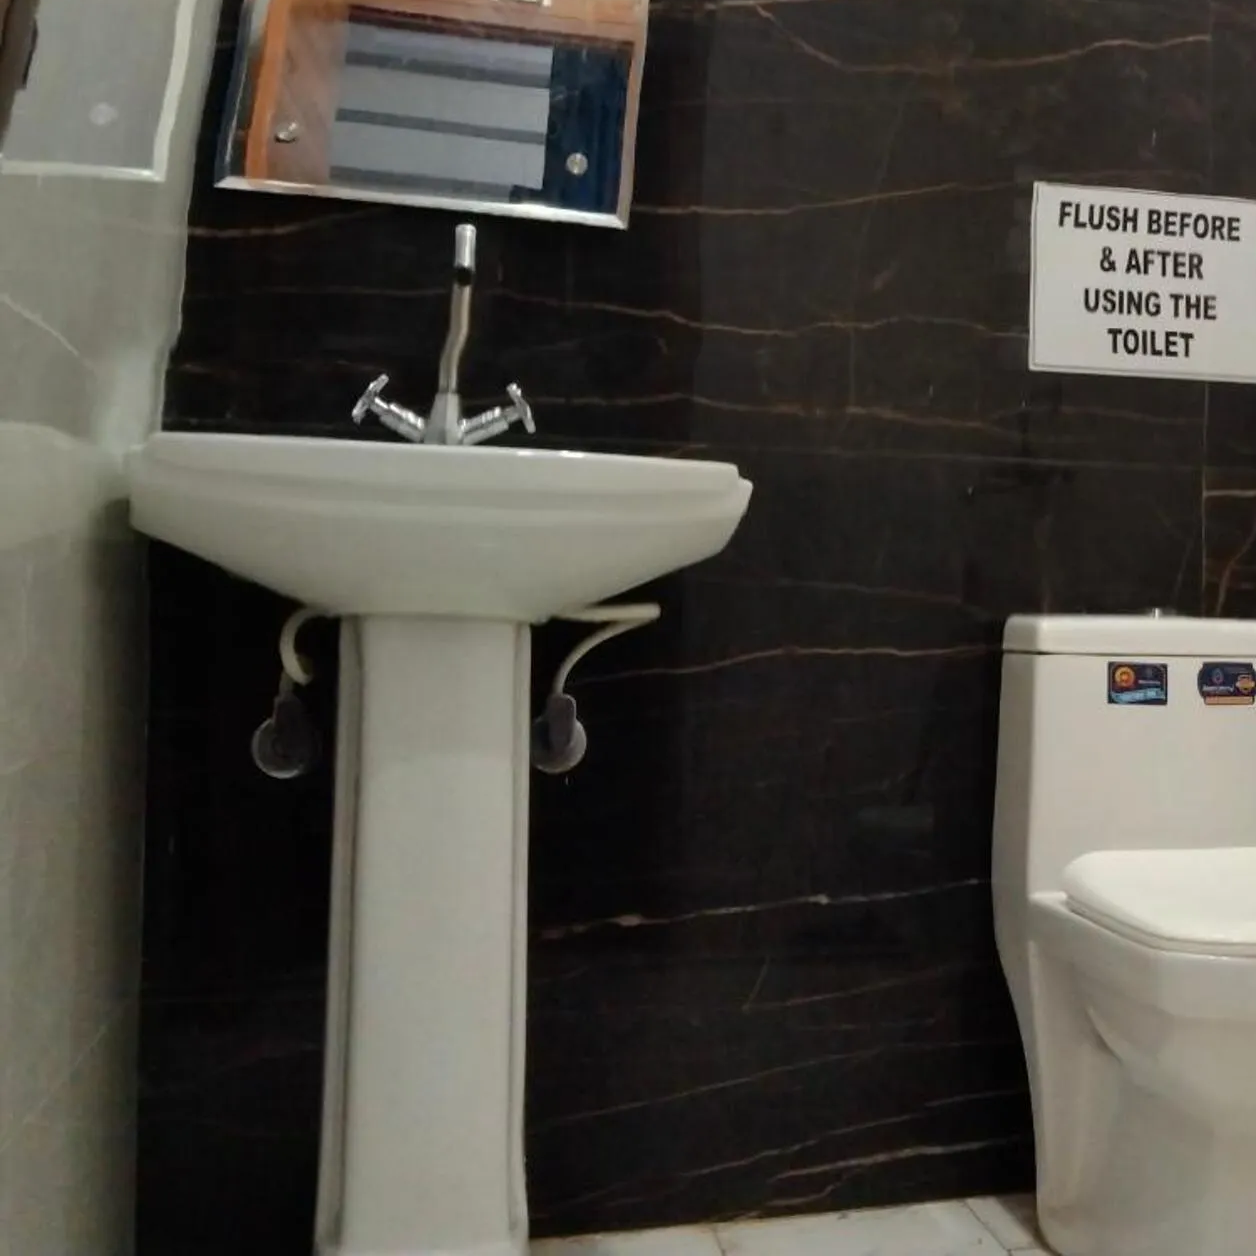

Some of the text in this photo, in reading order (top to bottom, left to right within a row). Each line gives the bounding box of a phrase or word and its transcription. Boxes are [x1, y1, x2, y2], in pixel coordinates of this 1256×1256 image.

[1058, 201, 1240, 241] FLUSH BEFORE
[1100, 246, 1203, 279] & AFTER
[1083, 288, 1217, 320] USING THE
[1107, 328, 1194, 357] TOILET
